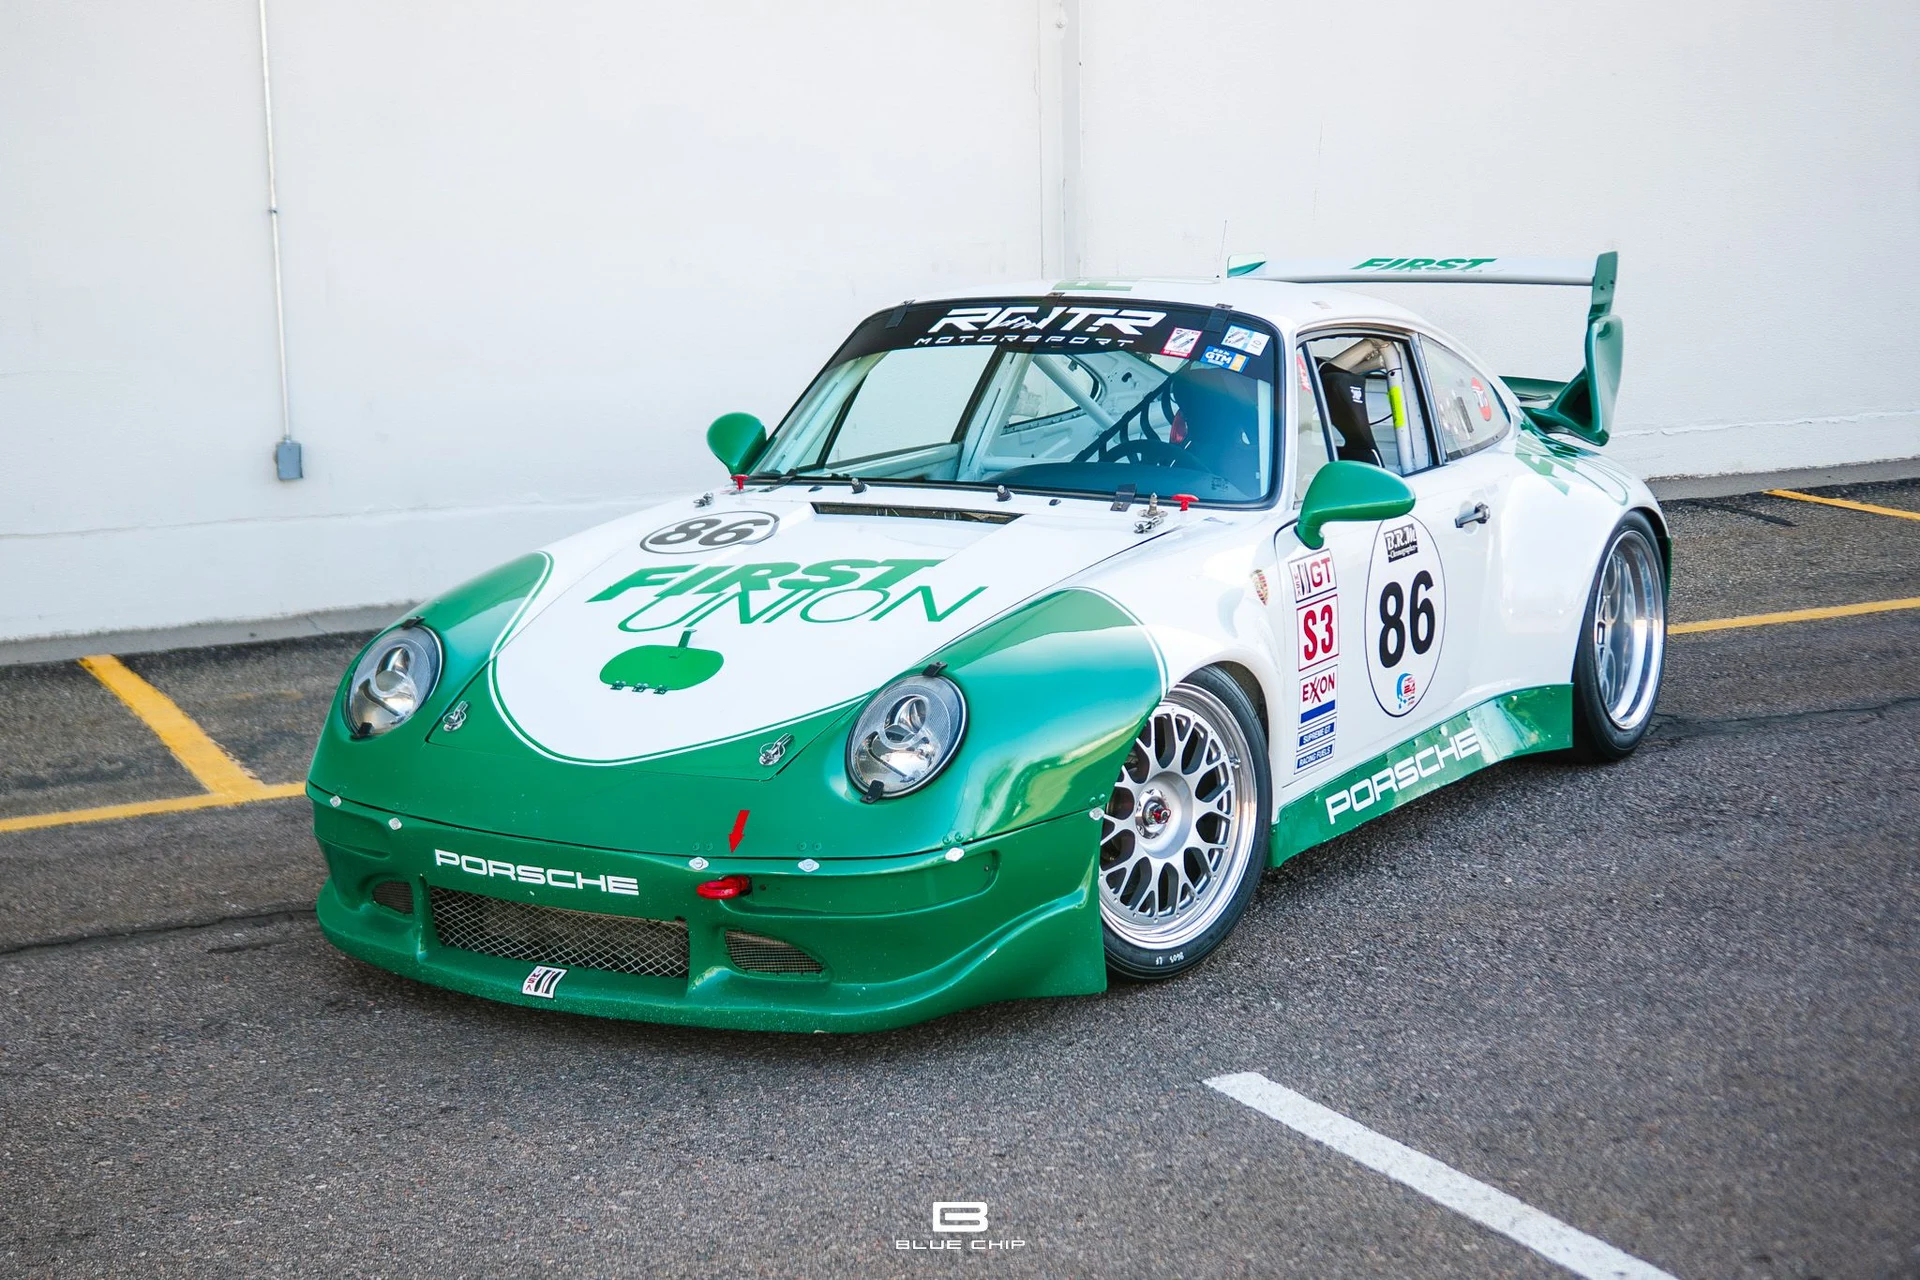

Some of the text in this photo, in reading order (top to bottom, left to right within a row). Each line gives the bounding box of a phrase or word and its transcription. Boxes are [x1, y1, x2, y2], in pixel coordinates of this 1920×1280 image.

[1352, 258, 1498, 269] FIRST
[914, 334, 1134, 347] MOTORSPORT
[1205, 351, 1233, 364] GTM
[648, 517, 771, 547] 86
[585, 559, 946, 603] FIRST
[1310, 557, 1331, 588] GT
[617, 586, 989, 633] UNION
[1379, 570, 1436, 669] 86
[1303, 604, 1333, 661] S3
[1302, 672, 1335, 704] EXXON
[1325, 730, 1481, 825] PORSCHE
[434, 849, 639, 896] PORSCHE
[525, 968, 542, 991] IMSA
